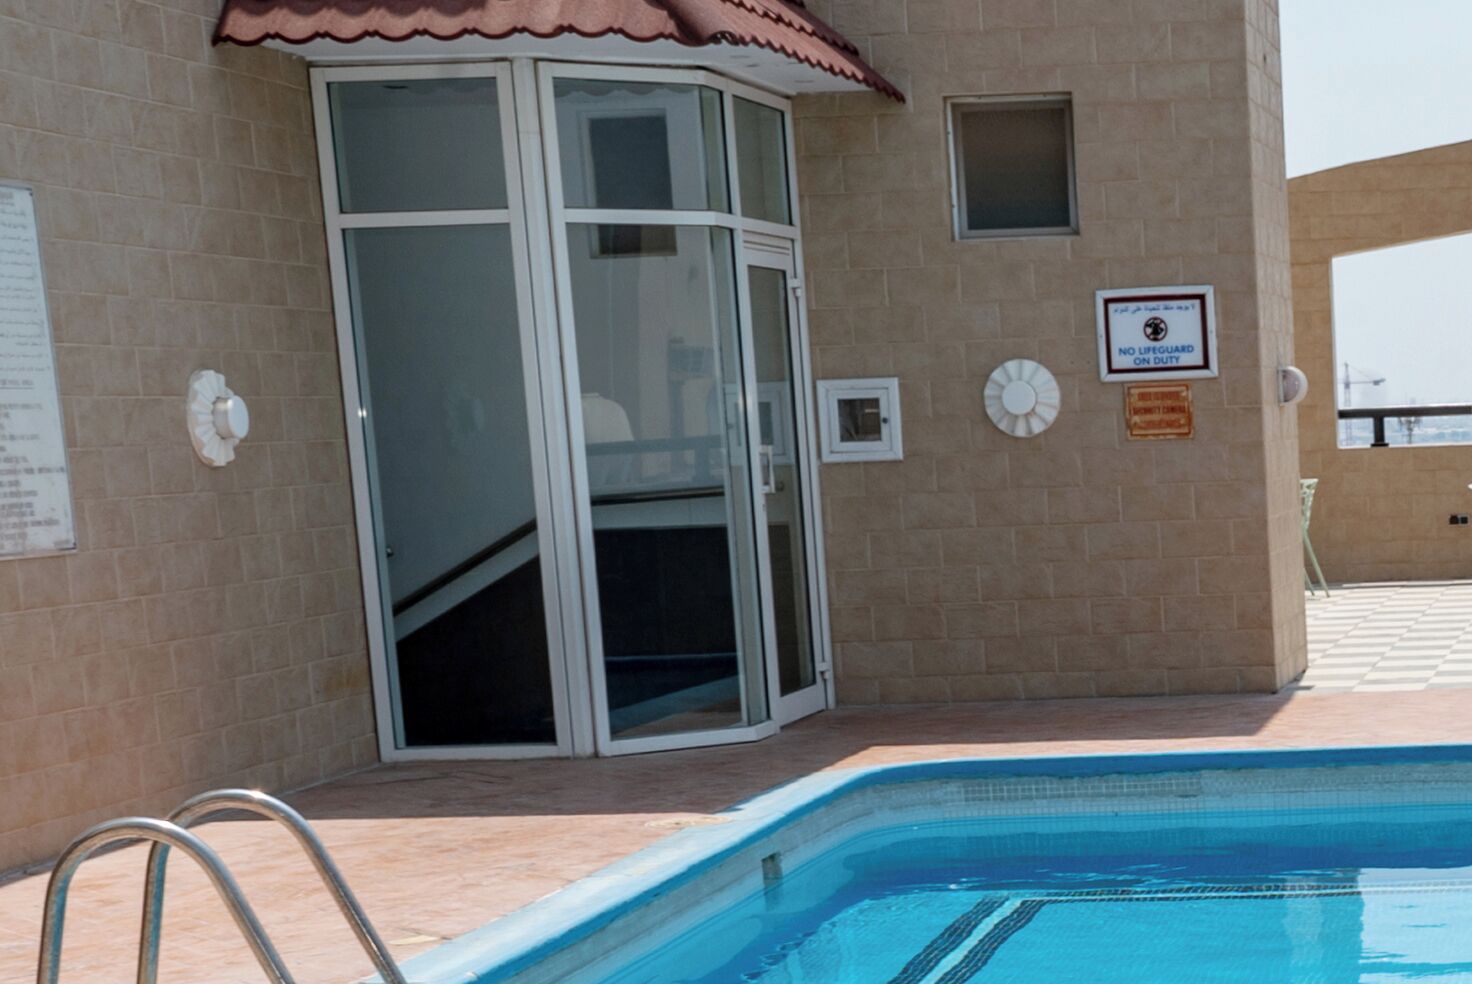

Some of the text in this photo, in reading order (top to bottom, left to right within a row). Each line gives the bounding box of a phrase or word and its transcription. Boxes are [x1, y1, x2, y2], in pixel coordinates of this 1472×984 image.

[1118, 344, 1195, 356] NO LIFEGUARD
[1133, 355, 1181, 366] ON DUTY
